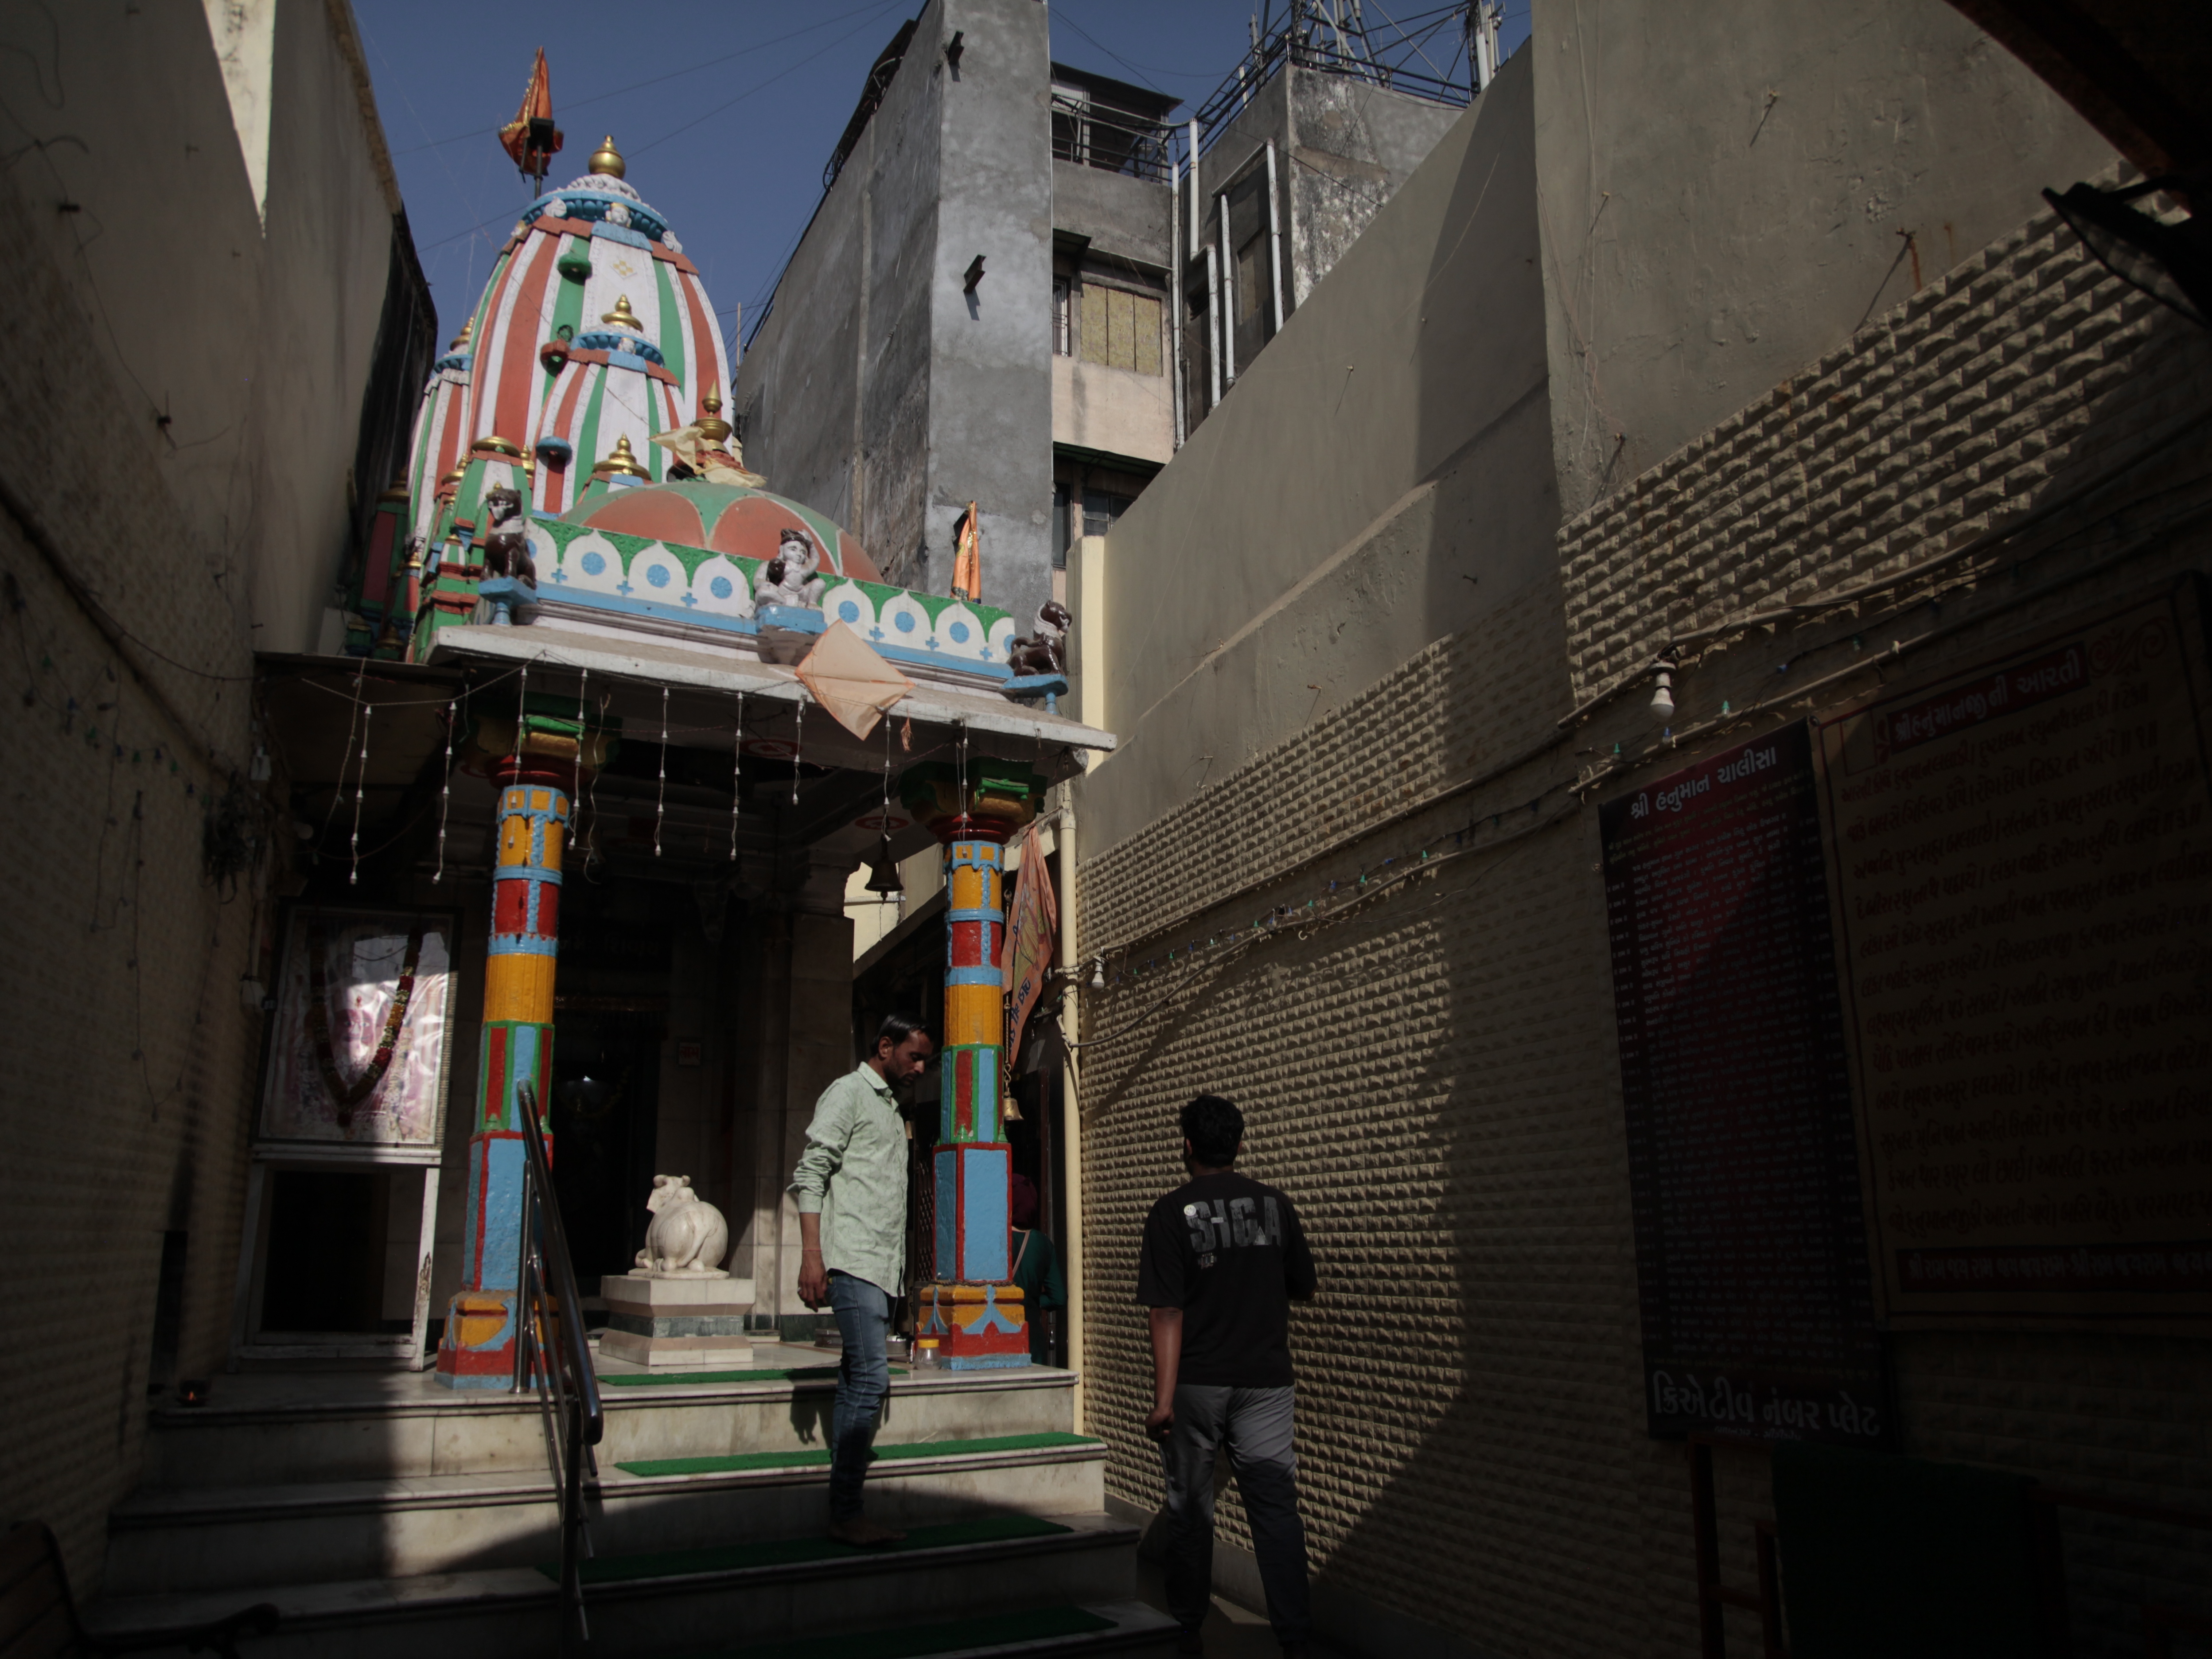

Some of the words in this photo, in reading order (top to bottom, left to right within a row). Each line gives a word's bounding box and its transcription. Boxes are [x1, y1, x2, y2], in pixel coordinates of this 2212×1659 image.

[2016, 648, 2080, 693] આરતી
[1631, 792, 1649, 819] શ્રી
[1656, 774, 1710, 812] હનુમાન
[1717, 747, 1776, 783] ચાલીસા
[1908, 1252, 1923, 1280] શ્રી
[1924, 1259, 1946, 1280] રામ
[1946, 1258, 1969, 1280] જય
[1653, 1370, 1754, 1422] ક્રિએટીવ
[1763, 1386, 1820, 1429] નંબર
[1828, 1390, 1880, 1436] પ્લેટ
